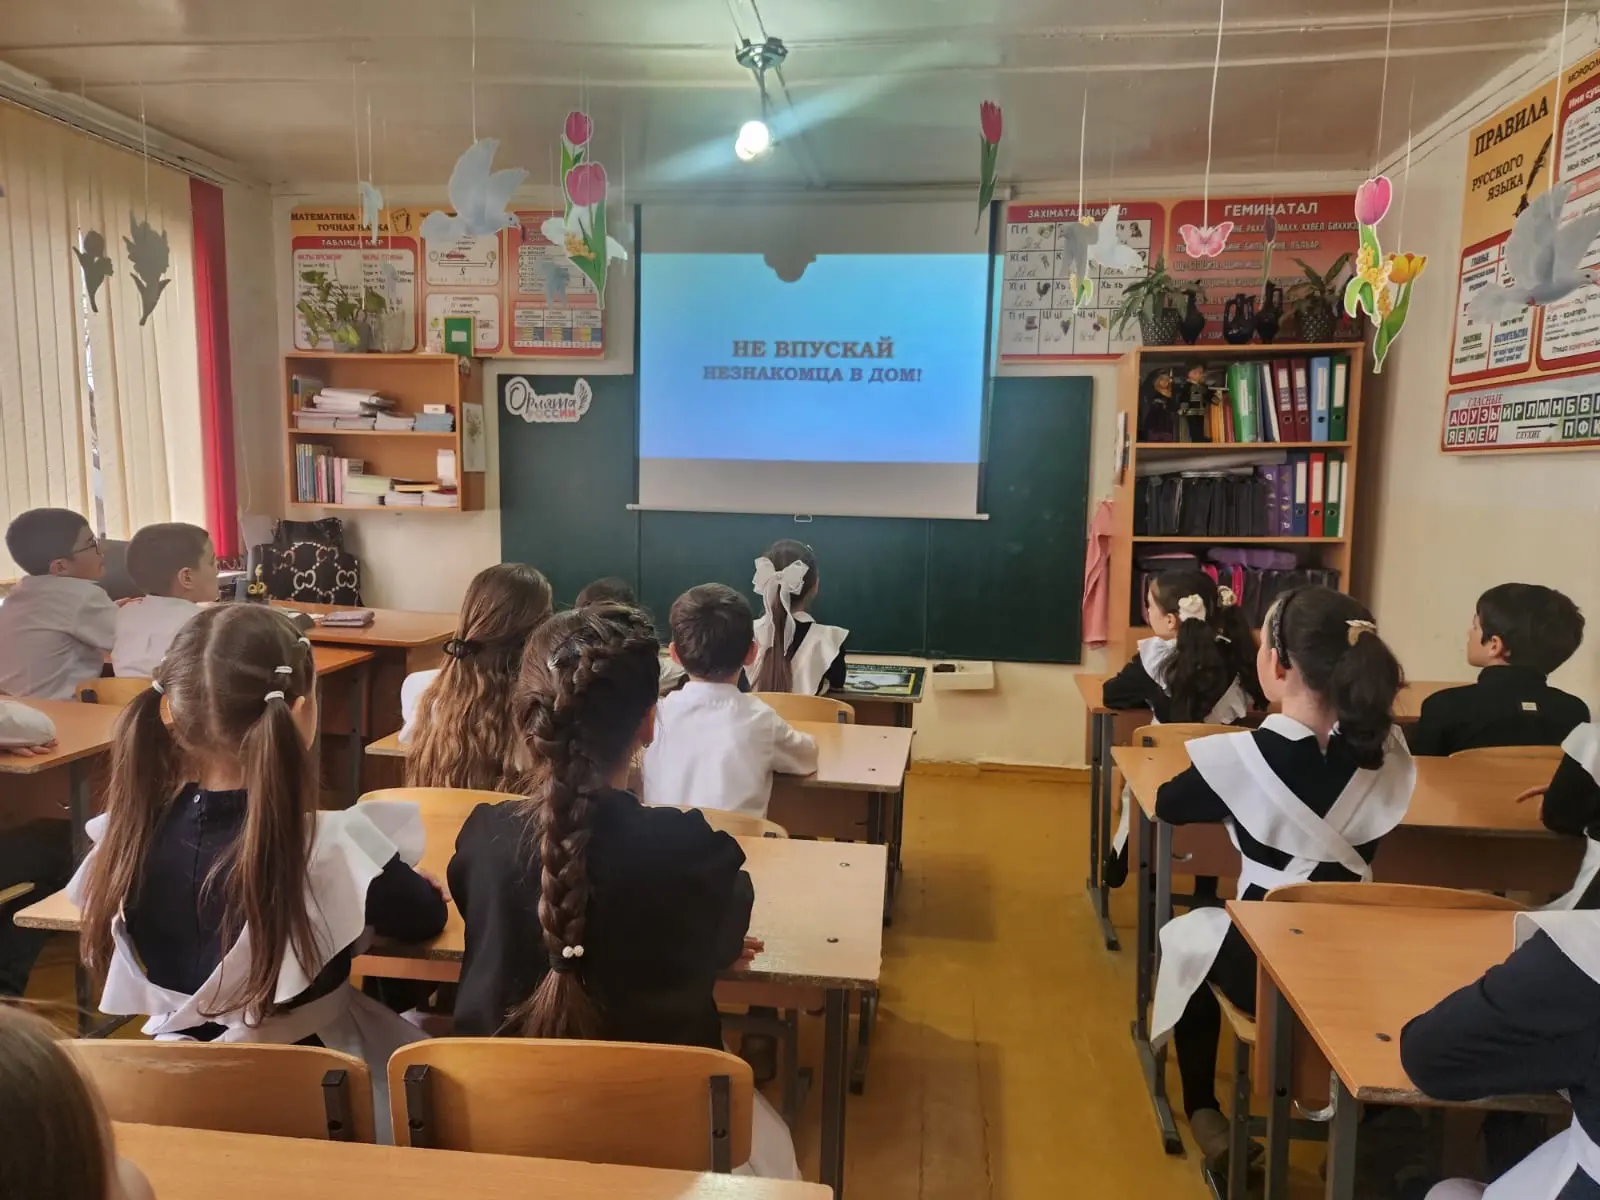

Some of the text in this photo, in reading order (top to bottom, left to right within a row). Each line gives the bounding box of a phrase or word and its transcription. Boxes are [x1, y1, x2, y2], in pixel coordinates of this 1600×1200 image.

[1474, 96, 1549, 156] ПРАВИЛА
[1472, 154, 1524, 191] РУССКОГО
[1487, 173, 1524, 201] ЯЗЫКА
[291, 212, 355, 220] МАТЕМАТИКА
[1224, 202, 1318, 217] ГЕМИНАТАЛ
[732, 336, 893, 358] НЕ ВПУСКАЙ
[703, 366, 922, 383] НЕЗНАКОМЦА В ДОМ!
[1467, 393, 1504, 407] ГЛАСНЫЕ
